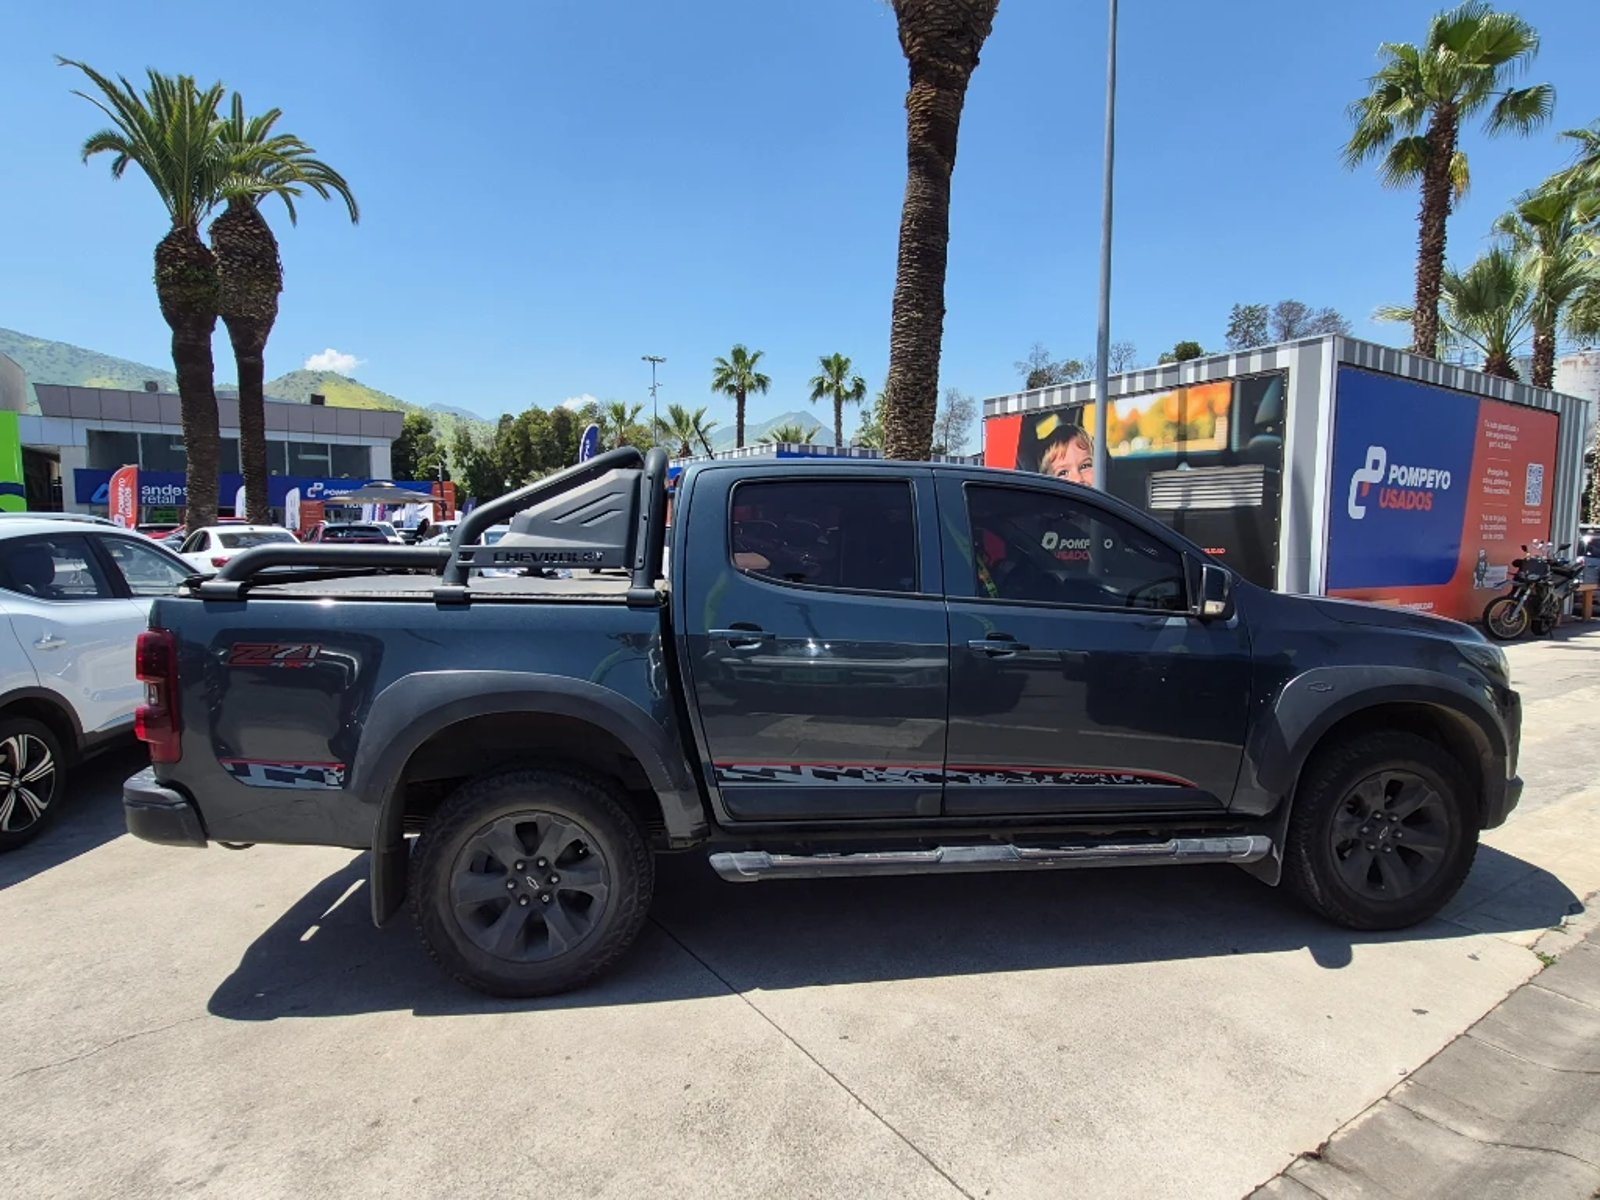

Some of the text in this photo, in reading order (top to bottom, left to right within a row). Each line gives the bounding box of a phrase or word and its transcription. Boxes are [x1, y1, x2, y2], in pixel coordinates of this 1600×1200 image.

[1387, 464, 1451, 490] POMPEYO
[141, 494, 176, 505] retail
[1379, 488, 1434, 511] USADOS
[493, 551, 606, 564] CHEVROLET
[227, 642, 321, 667] Z71
